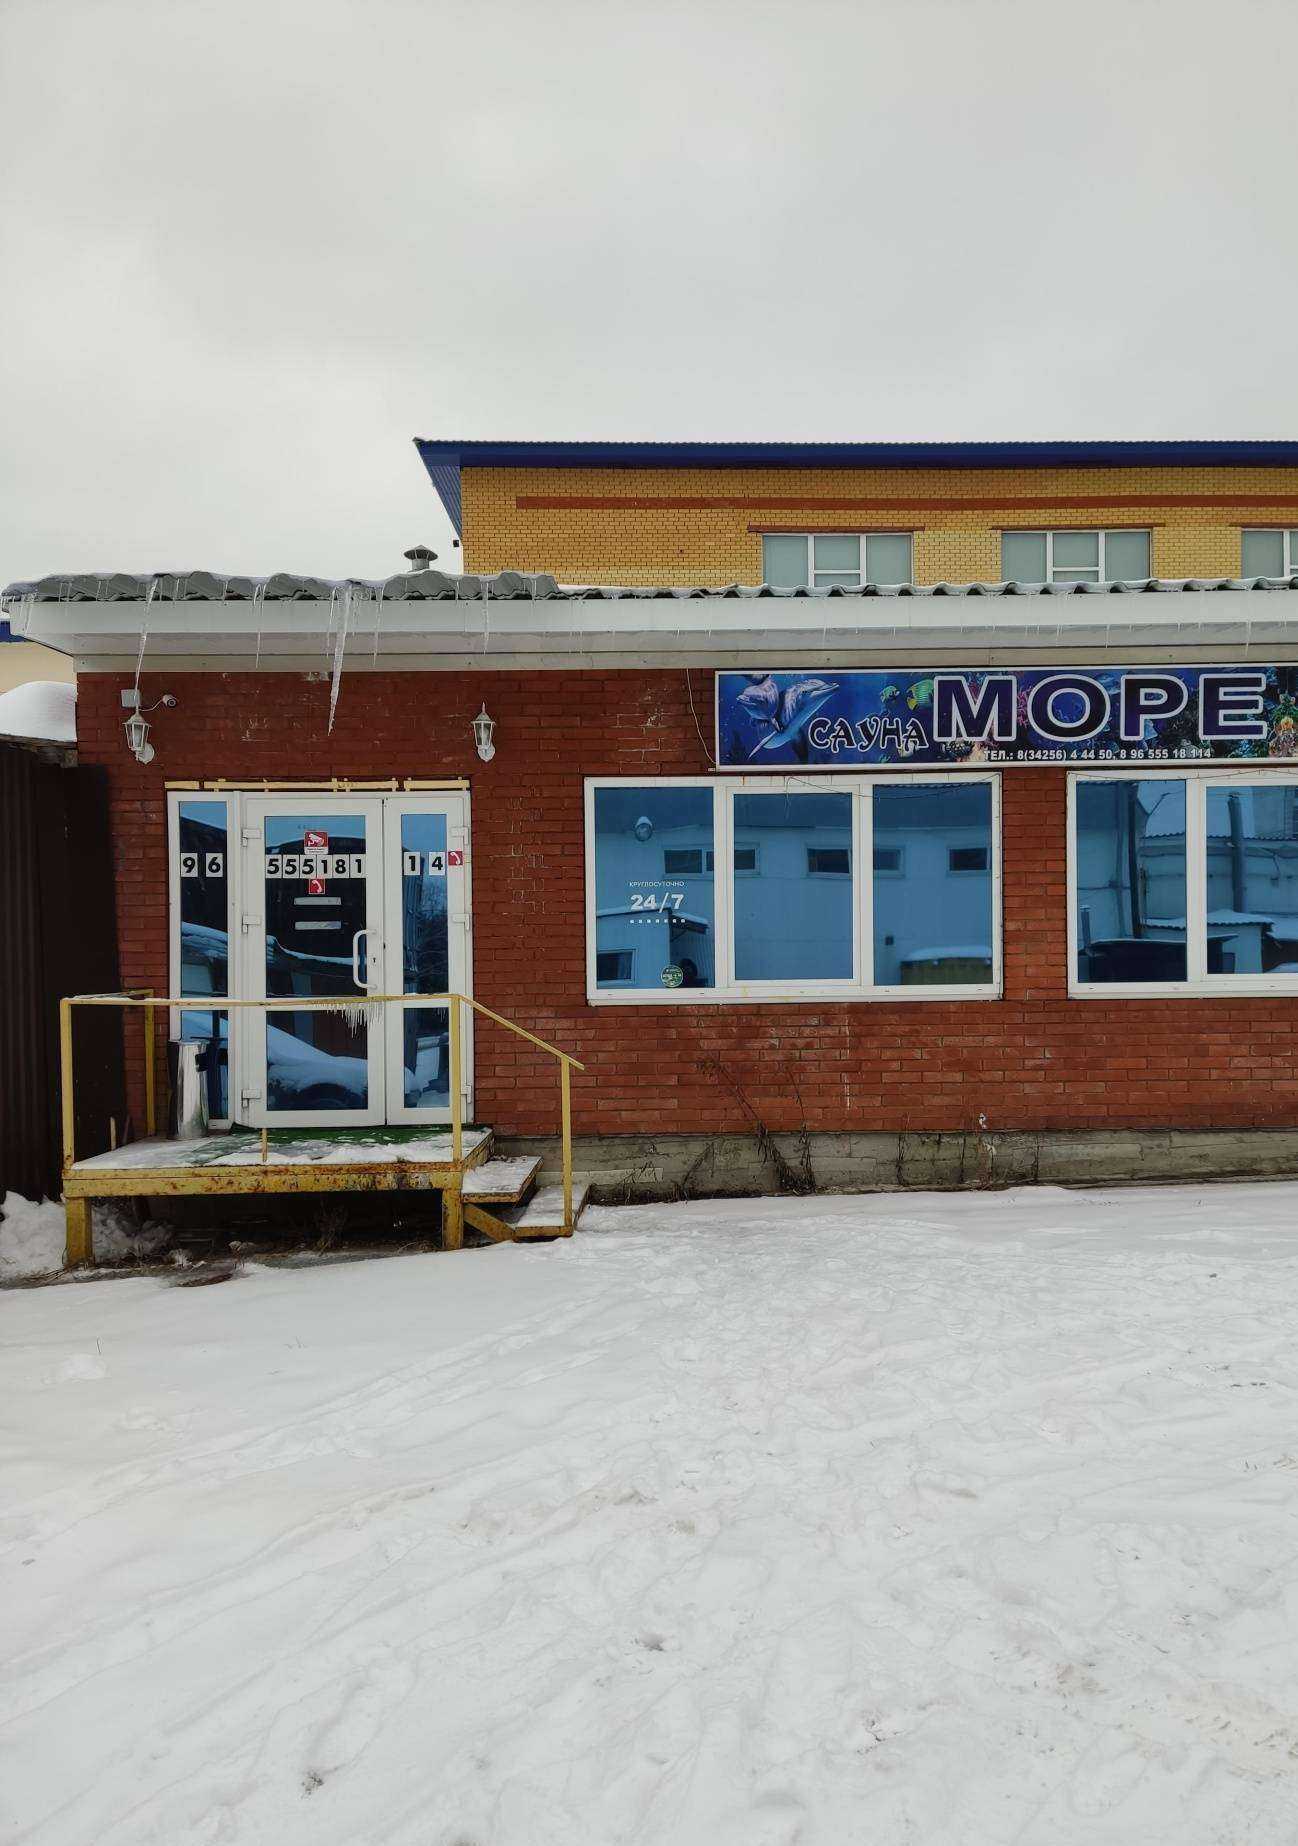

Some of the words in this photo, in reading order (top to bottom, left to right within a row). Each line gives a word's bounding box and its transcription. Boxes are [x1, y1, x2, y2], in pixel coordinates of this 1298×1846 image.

[808, 717, 929, 753] САУНА
[933, 673, 1268, 742] МОРЕ
[983, 749, 1014, 760] ТЕЛ.:
[1017, 749, 1067, 761] 8(34256)
[1070, 749, 1078, 760] 4
[1080, 749, 1096, 760] 44
[1099, 749, 1117, 761] 50,
[1120, 749, 1127, 759] 8
[1130, 749, 1145, 759] 96
[1148, 749, 1169, 759] 555
[267, 858, 362, 875] 555181
[630, 892, 685, 913] 24/7
